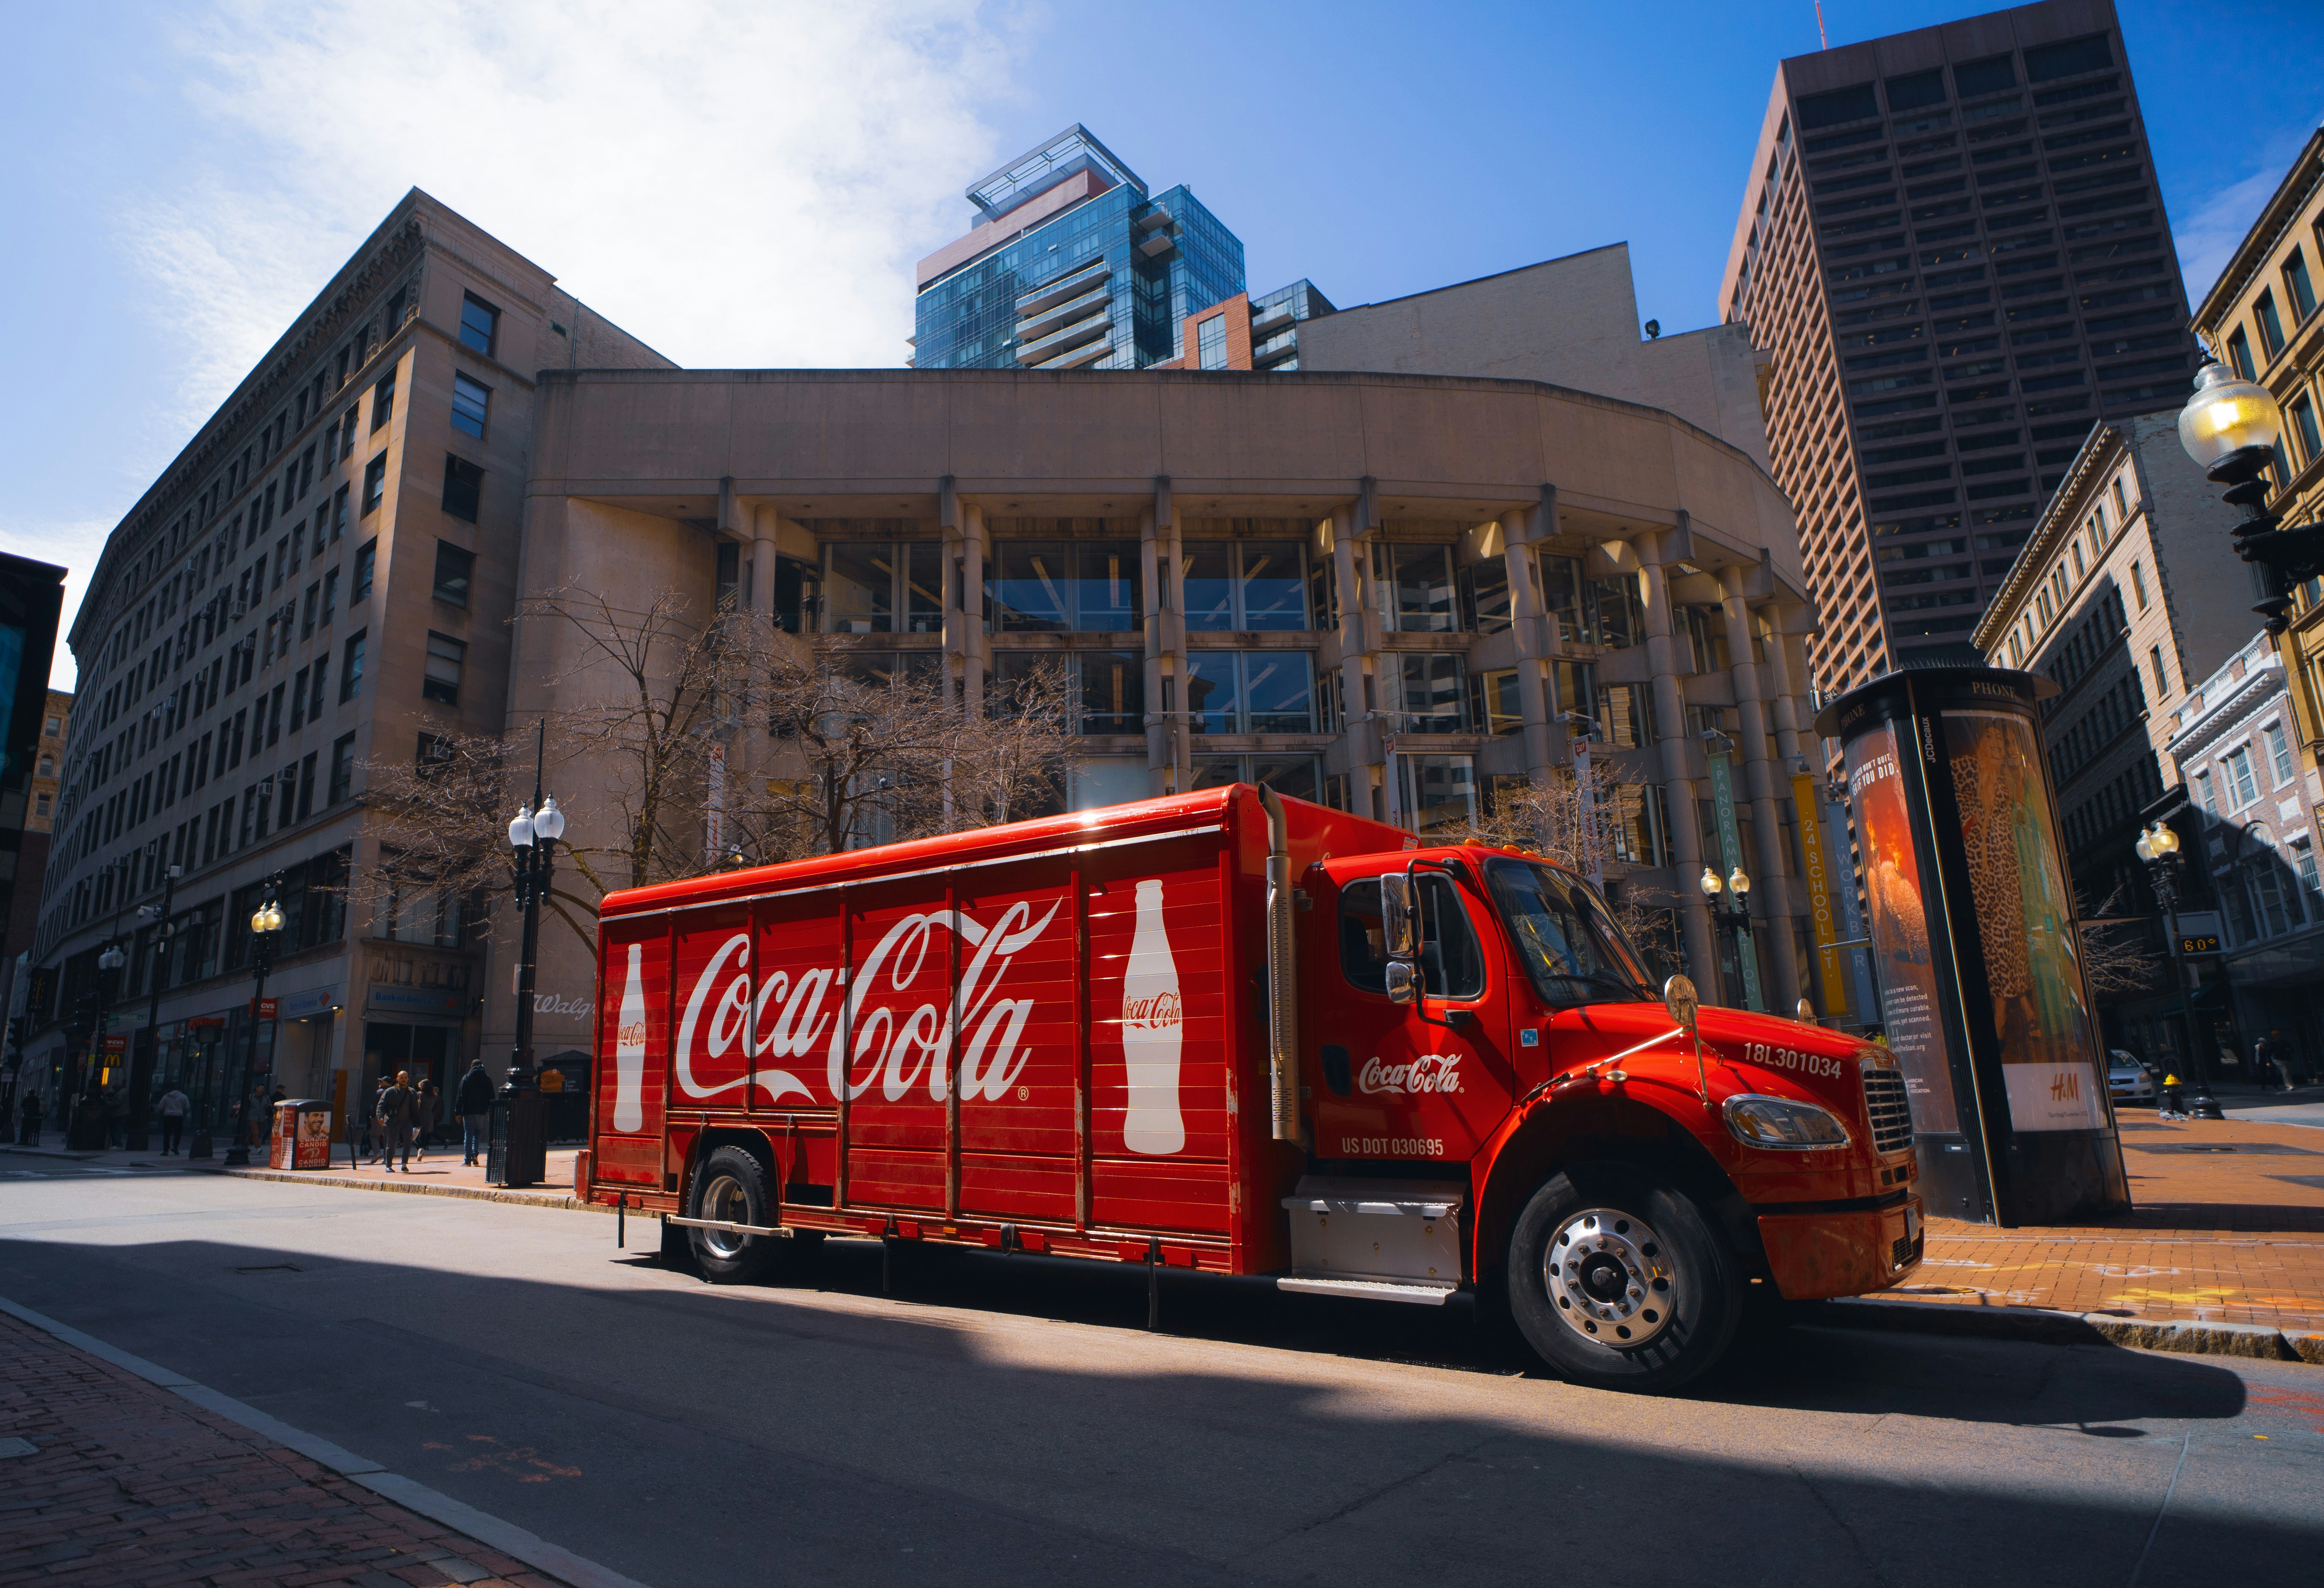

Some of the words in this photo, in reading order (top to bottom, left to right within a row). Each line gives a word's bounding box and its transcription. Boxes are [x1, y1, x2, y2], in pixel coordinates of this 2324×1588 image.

[1972, 682, 2017, 698] PHONE
[1840, 703, 1865, 730] PHONE
[1922, 717, 1936, 762] JCDecaux
[1857, 778, 1861, 791] IF
[1862, 770, 1875, 786] YOU
[1878, 762, 1899, 779] DID.
[1862, 759, 1875, 772] WON'T
[1877, 753, 1892, 764] QUIT.
[1716, 770, 1737, 868] PANORAMA
[1805, 820, 1816, 845] 24
[1809, 851, 1828, 936] SCHOOL
[1837, 853, 1865, 967] WORKBR
[375, 992, 395, 1002] Bank
[406, 995, 438, 1005] America
[676, 896, 1062, 1104] Coca-Cola
[1124, 992, 1182, 1029] Coca-Cola
[1906, 993, 1928, 1002] detected
[617, 1021, 646, 1047] Coca-Cola
[1359, 1054, 1462, 1094] Coca-Cola
[1744, 1042, 1841, 1079] 18L301034
[2050, 1072, 2078, 1102] H&M
[1343, 1138, 1359, 1154] US
[1363, 1138, 1388, 1154] DOT
[1392, 1139, 1443, 1156] 030695
